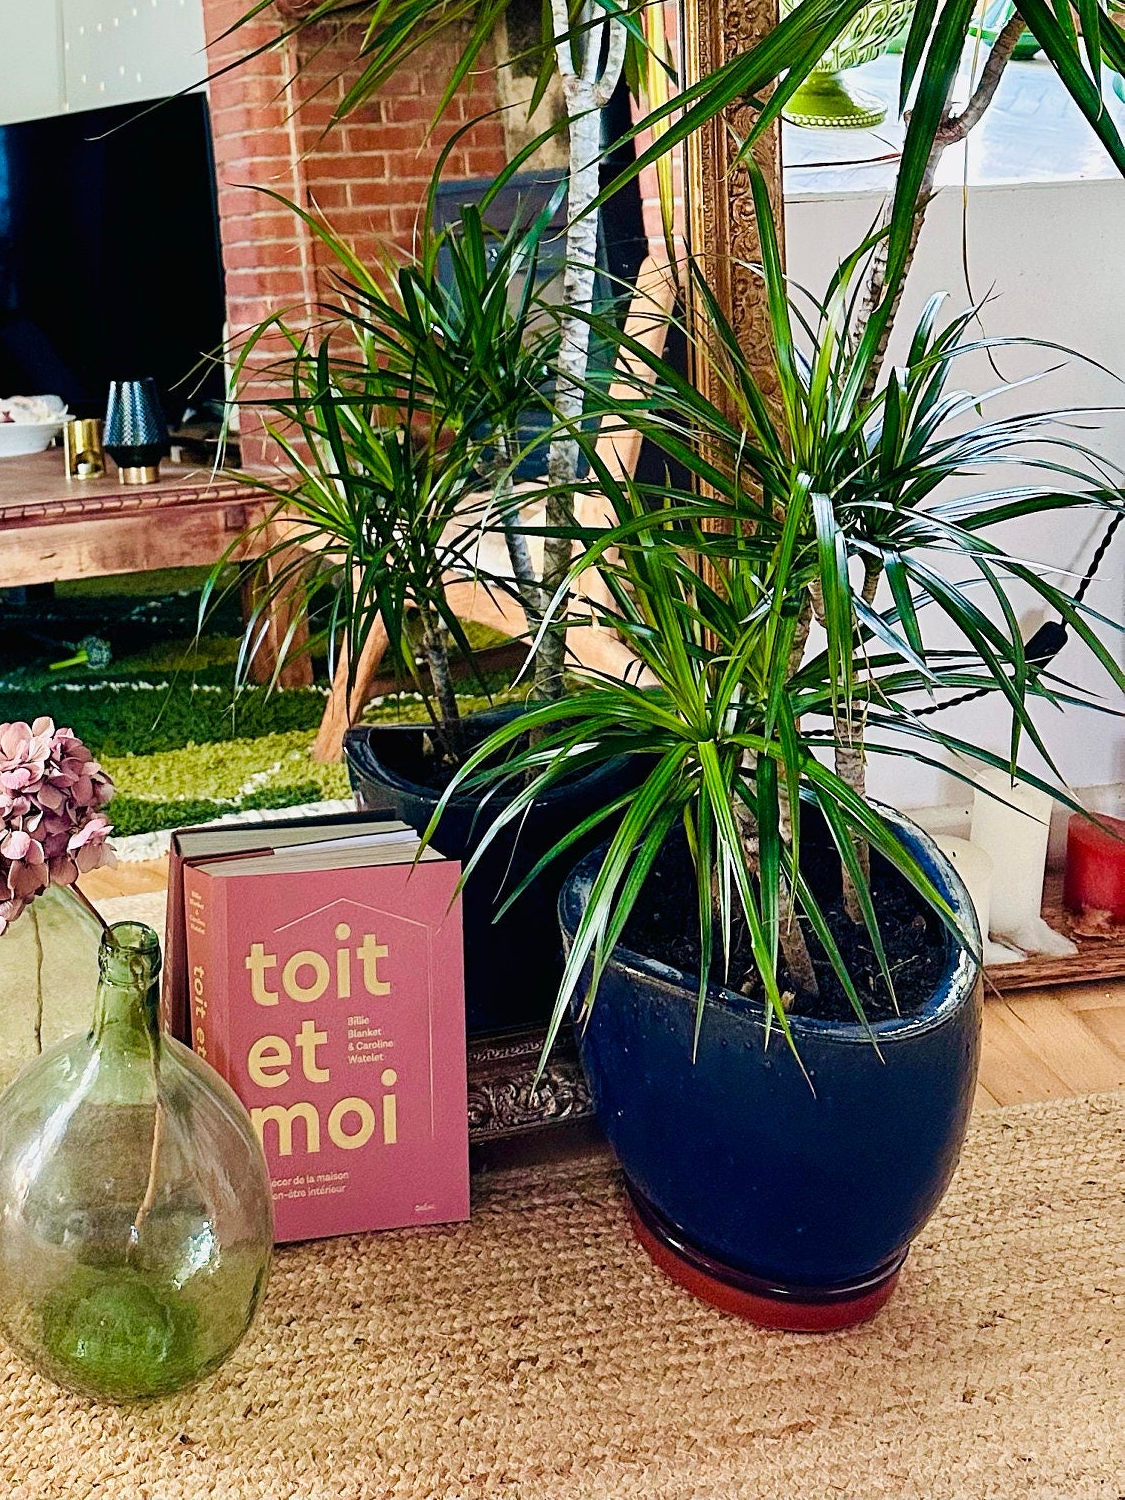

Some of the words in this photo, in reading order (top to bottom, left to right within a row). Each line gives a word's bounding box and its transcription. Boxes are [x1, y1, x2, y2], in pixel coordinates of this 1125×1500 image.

[245, 922, 391, 1007] toit
[193, 965, 208, 1019] toit
[347, 1015, 370, 1026] Billie
[347, 1028, 382, 1039] Blanket
[195, 1026, 207, 1059] et
[348, 1042, 355, 1051] &
[356, 1039, 395, 1051] Caroline
[248, 1020, 330, 1089] et
[347, 1053, 385, 1064] Watelet
[250, 1069, 398, 1157] moi
[293, 1175, 305, 1185] de
[306, 1174, 315, 1183] la
[316, 1171, 350, 1183] maison
[307, 1184, 347, 1197] intérieur
